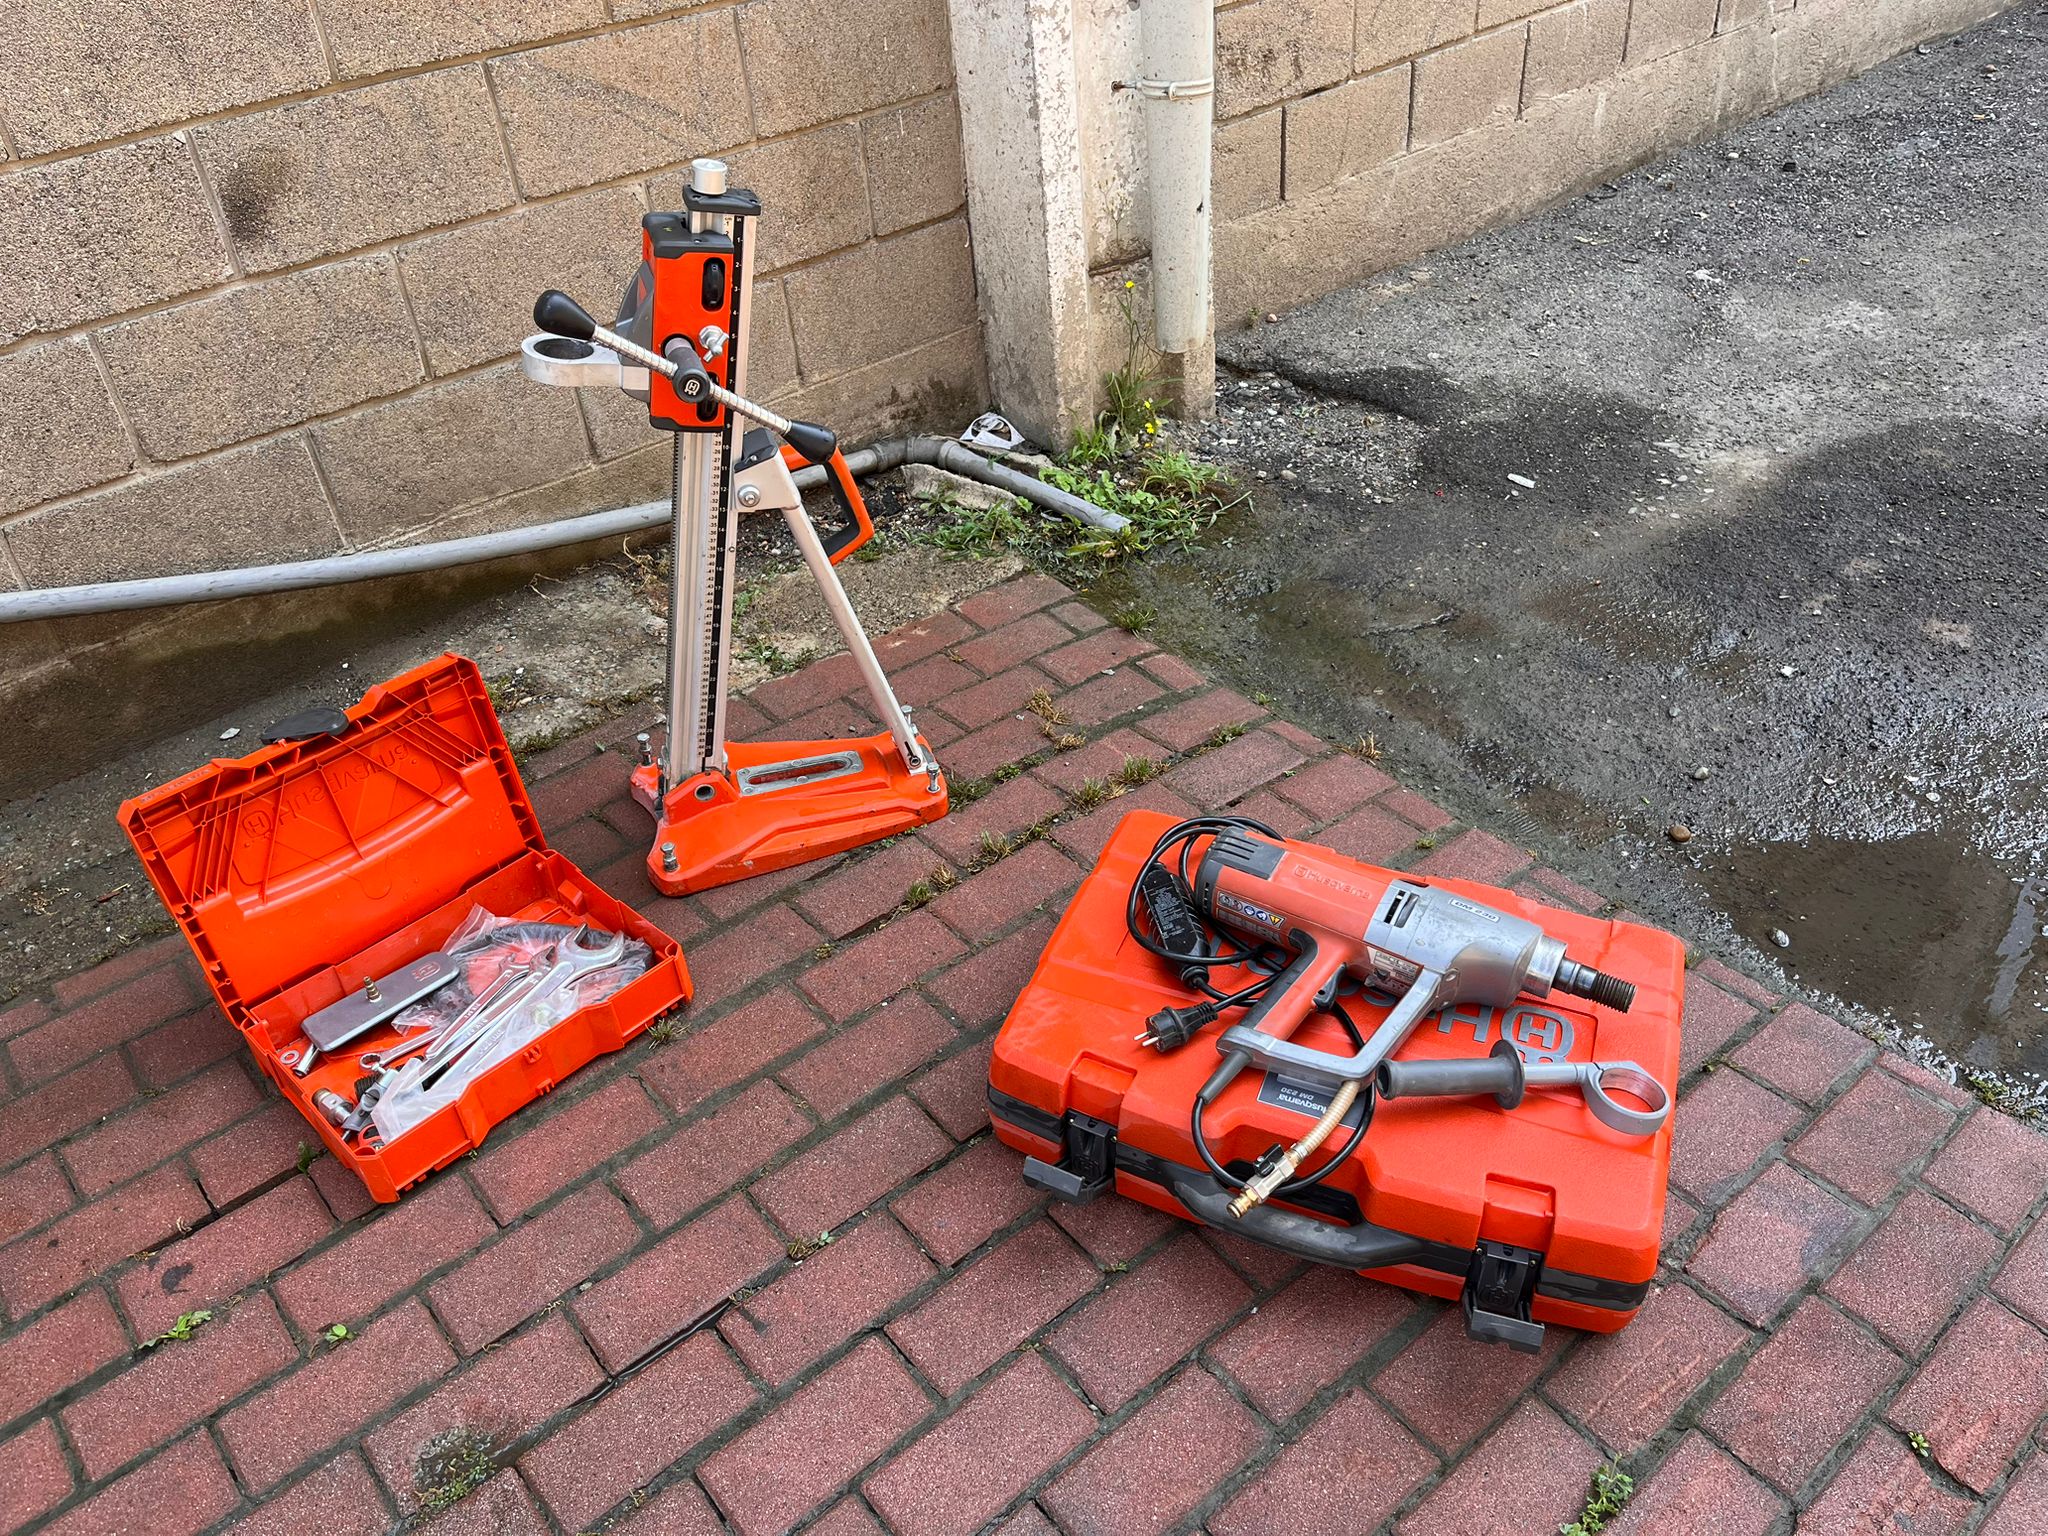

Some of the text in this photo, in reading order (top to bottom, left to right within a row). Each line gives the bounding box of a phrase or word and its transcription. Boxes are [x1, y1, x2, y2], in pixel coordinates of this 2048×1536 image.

[1306, 870, 1371, 900] Husqvarna
[1455, 901, 1472, 910] DM
[1280, 1086, 1314, 1100] DM 230
